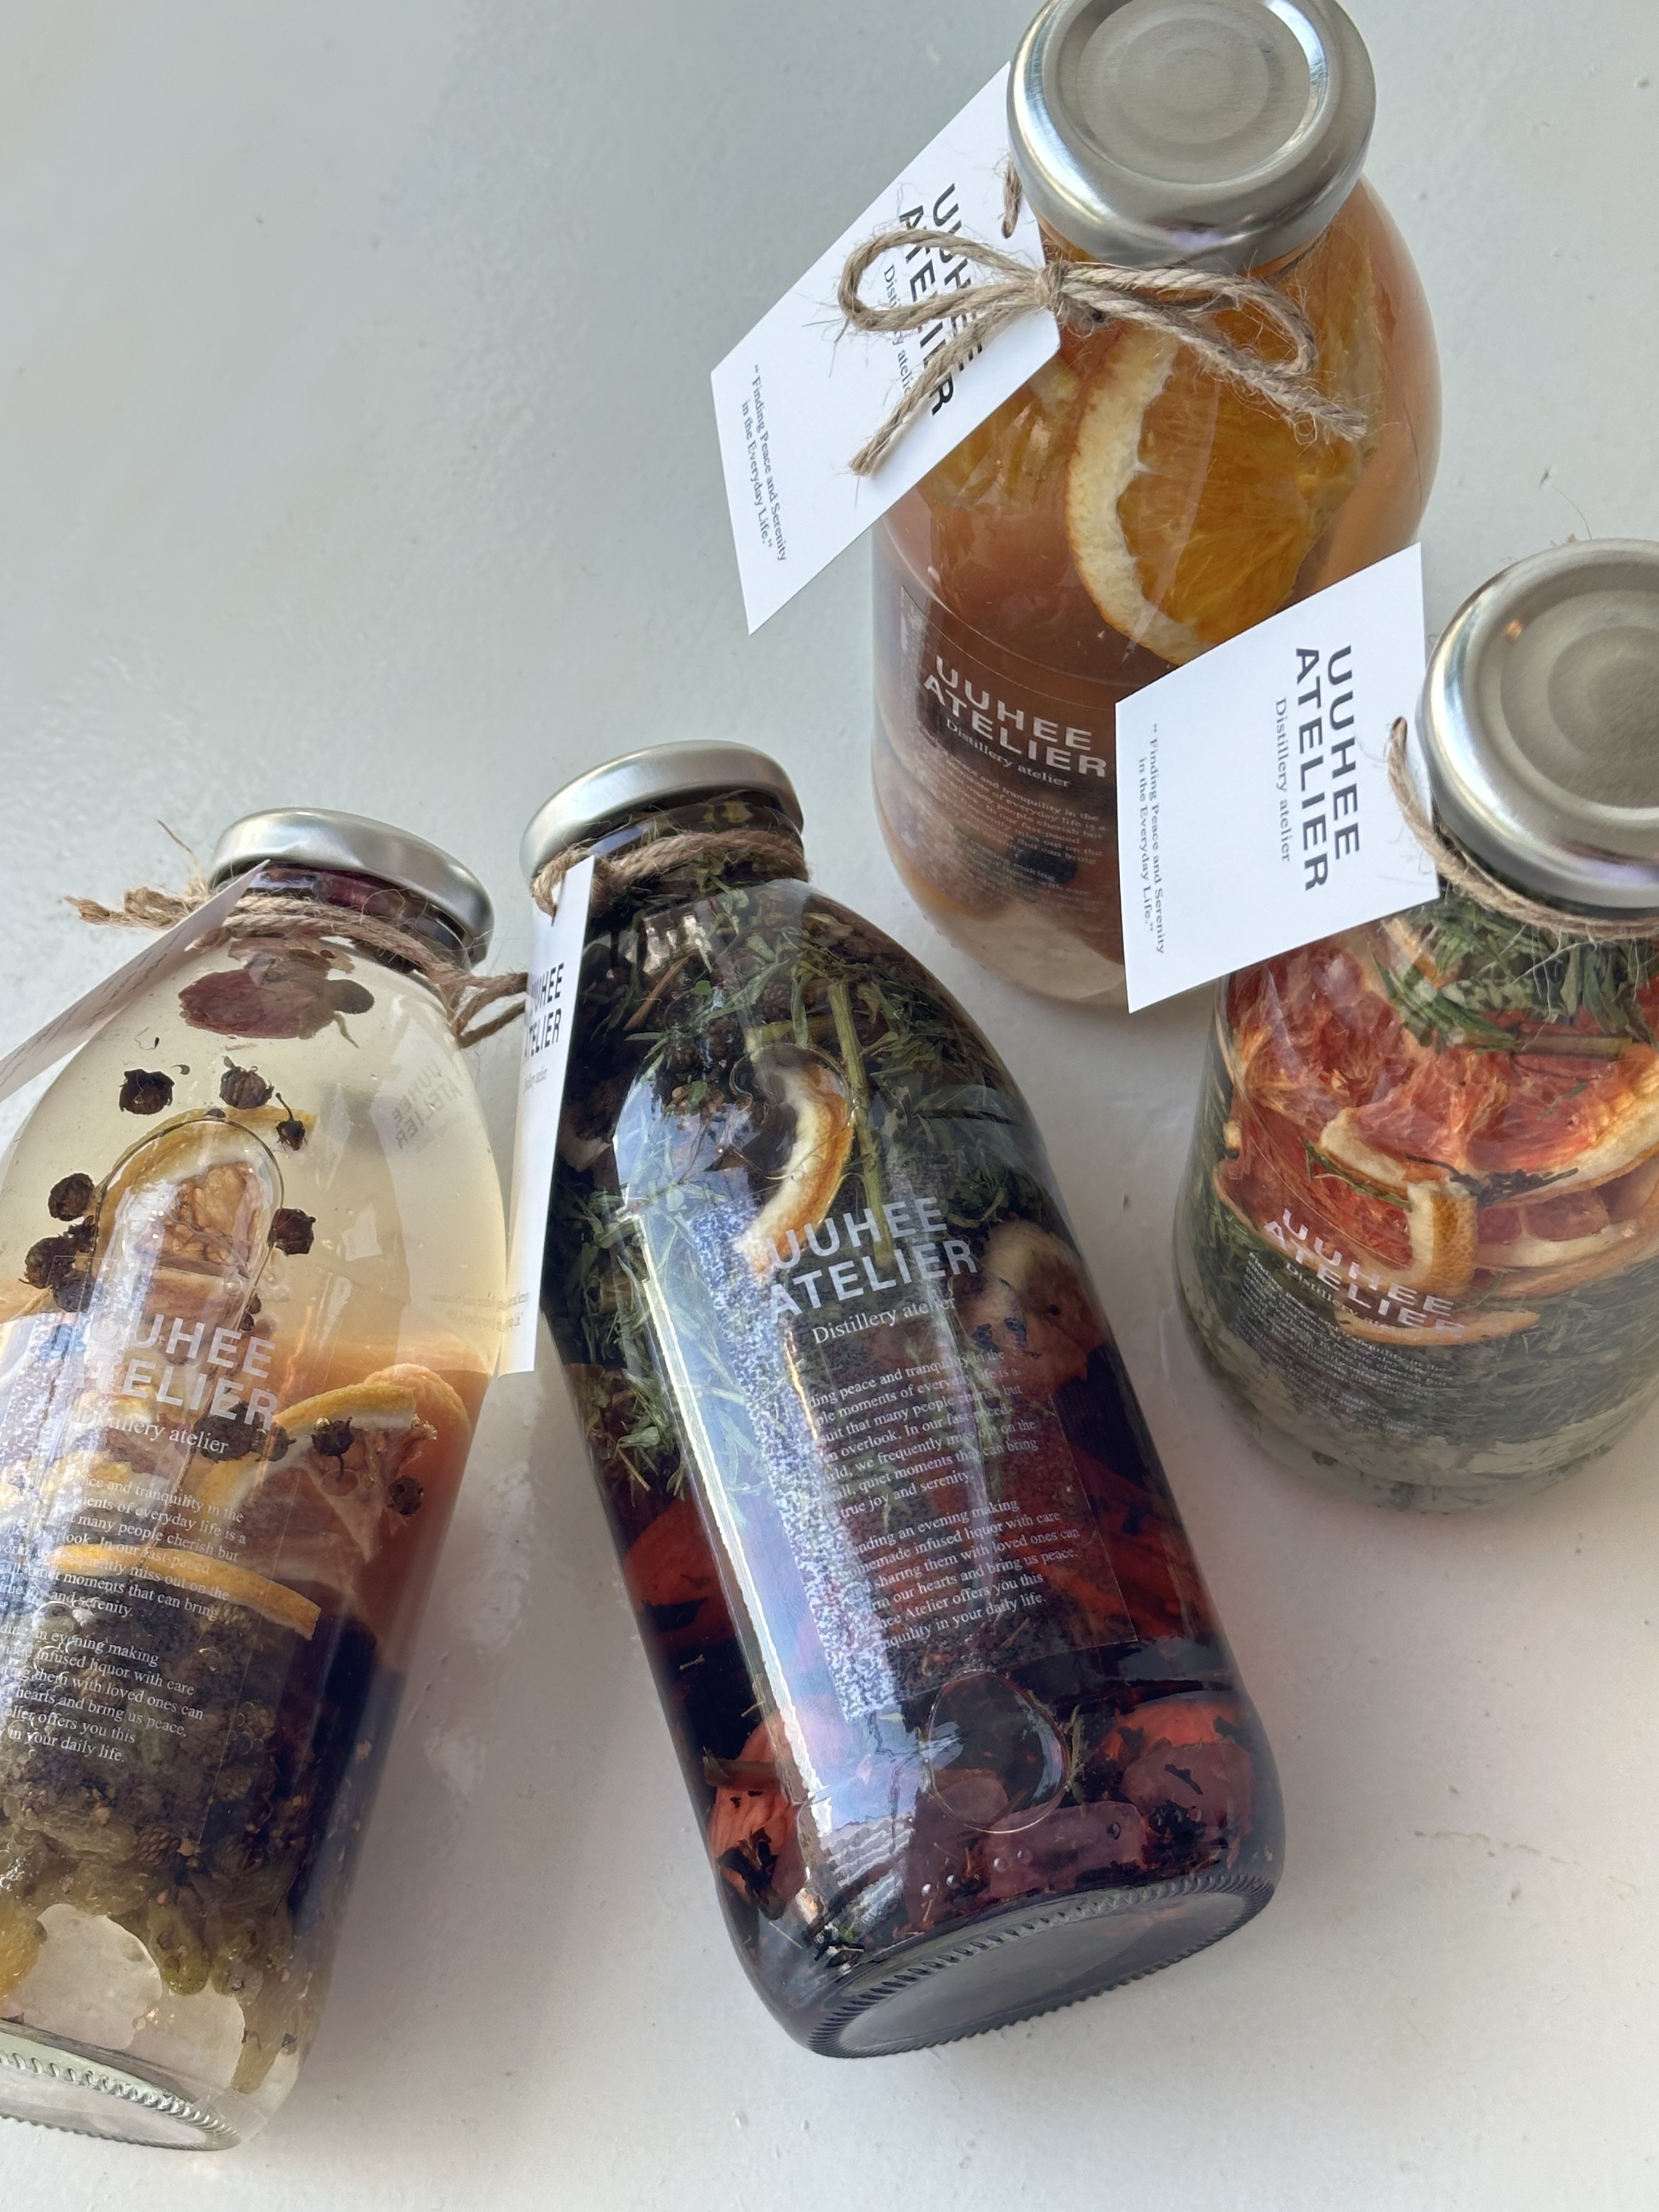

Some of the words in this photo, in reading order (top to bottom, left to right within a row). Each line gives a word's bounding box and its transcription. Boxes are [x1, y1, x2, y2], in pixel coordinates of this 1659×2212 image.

[742, 398, 752, 417] in
[744, 417, 753, 440] the
[748, 440, 764, 506] Everyday
[760, 430, 771, 475] Peace
[766, 475, 778, 504] and
[771, 503, 786, 561] Serenity
[924, 674, 1107, 778] ATELIER
[936, 654, 1092, 752] UUHEE
[946, 718, 1013, 768] Distillery
[1017, 765, 1071, 788] atelier
[1139, 757, 1146, 769] in
[1275, 696, 1290, 793] Distillery
[1327, 645, 1359, 860] UUHEE
[1296, 648, 1329, 891] ATELIER
[980, 776, 999, 789] and
[1003, 785, 1062, 815] tranquility
[1080, 810, 1099, 821] the
[1007, 799, 1059, 822] everyday
[1139, 806, 1149, 881] Everyday
[1150, 803, 1160, 851] Peace
[1279, 798, 1290, 862] atelier
[1153, 856, 1162, 884] and
[1155, 888, 1165, 955] Serenity
[768, 1197, 947, 1268] UUHEE
[769, 1240, 977, 1323] ATELIER
[128, 1310, 275, 1379] UHEE
[812, 1309, 896, 1344] Distillery
[903, 1298, 956, 1318] atelier
[838, 1392, 897, 1418] moments
[900, 1384, 915, 1398] of
[917, 1375, 972, 1393] everyday
[1000, 1367, 1009, 1378] is
[839, 1379, 877, 1400] peace
[880, 1368, 903, 1384] and
[905, 1357, 968, 1377] tranquility
[973, 1353, 984, 1362] in
[987, 1349, 1005, 1363] the
[846, 1419, 871, 1434] that
[873, 1408, 908, 1426] many
[912, 1396, 955, 1417] people
[958, 1387, 1001, 1403] cherish
[1002, 1385, 1022, 1396] but
[169, 1427, 229, 1454] atelier
[841, 1430, 902, 1457] overlook.
[905, 1424, 918, 1436] In
[922, 1419, 943, 1431] our
[855, 1459, 874, 1471] we
[877, 1437, 941, 1464] frequently
[946, 1430, 975, 1446] miss
[1001, 1424, 1015, 1435] on
[1018, 1420, 1036, 1431] the
[859, 1472, 891, 1494] quiet
[894, 1455, 953, 1480] moments
[956, 1449, 979, 1463] that
[983, 1445, 1004, 1455] can
[1006, 1439, 1039, 1451] bring
[106, 1481, 132, 1493] and
[136, 1486, 204, 1513] tranquility
[207, 1504, 219, 1516] in
[224, 1507, 244, 1523] the
[840, 1502, 866, 1519] true
[869, 1494, 889, 1512] joy
[893, 1482, 917, 1500] and
[921, 1470, 974, 1492] serenity.
[77, 1516, 115, 1533] many
[118, 1523, 163, 1541] people
[167, 1533, 213, 1556] cherish
[218, 1545, 238, 1562] but
[117, 1502, 135, 1514] of
[135, 1507, 196, 1531] everyday
[200, 1520, 221, 1537] life
[224, 1527, 235, 1541] is
[238, 1534, 246, 1544] a
[899, 1527, 915, 1539] an
[917, 1511, 970, 1532] evening
[972, 1500, 1020, 1518] making
[913, 1528, 962, 1554] infused
[964, 1522, 1003, 1539] liquor
[1006, 1514, 1034, 1530] with
[1036, 1512, 1061, 1523] care
[116, 1543, 140, 1556] our
[874, 1565, 922, 1588] sharing
[923, 1555, 958, 1571] them
[961, 1544, 990, 1561] with
[992, 1534, 1028, 1553] loved
[1030, 1531, 1057, 1544] ones
[1060, 1528, 1080, 1538] can
[64, 1573, 125, 1593] moments
[128, 1584, 154, 1600] that
[158, 1594, 180, 1608] can
[184, 1598, 219, 1621] bring
[129, 1566, 162, 1582] miss
[165, 1575, 186, 1588] out
[190, 1582, 206, 1595] on
[208, 1584, 229, 1601] the
[893, 1588, 915, 1603] our
[917, 1575, 957, 1594] hearts
[961, 1565, 984, 1581] and
[987, 1556, 1023, 1574] bring
[1024, 1555, 1038, 1564] us
[1041, 1548, 1079, 1564] peace.
[906, 1598, 949, 1620] Atelier
[952, 1587, 990, 1604] offers
[993, 1578, 1018, 1596] you
[1020, 1571, 1043, 1586] this
[50, 1592, 76, 1604] and
[78, 1597, 133, 1617] serenity.
[936, 1618, 950, 1630] in
[952, 1608, 982, 1629] your
[986, 1599, 1017, 1616] daily
[1020, 1592, 1046, 1607] life.
[37, 1649, 87, 1668] infused
[89, 1657, 130, 1677] liquor
[134, 1670, 163, 1687] with
[167, 1680, 195, 1696] care
[52, 1632, 105, 1654] evening
[108, 1641, 160, 1668] making
[16, 1686, 56, 1703] hearts
[60, 1696, 86, 1709] and
[88, 1699, 125, 1723] bring
[128, 1711, 143, 1724] us
[146, 1717, 187, 1737] peace.
[32, 1668, 67, 1685] them
[72, 1678, 102, 1693] with
[106, 1682, 145, 1702] loved
[148, 1696, 178, 1712] ones
[182, 1706, 203, 1720] can
[9, 1728, 21, 1740] in
[25, 1731, 59, 1746] your
[61, 1736, 96, 1757] daily
[99, 1744, 125, 1763] life.
[38, 1712, 78, 1729] offers
[80, 1723, 107, 1736] you
[111, 1728, 136, 1743] this
